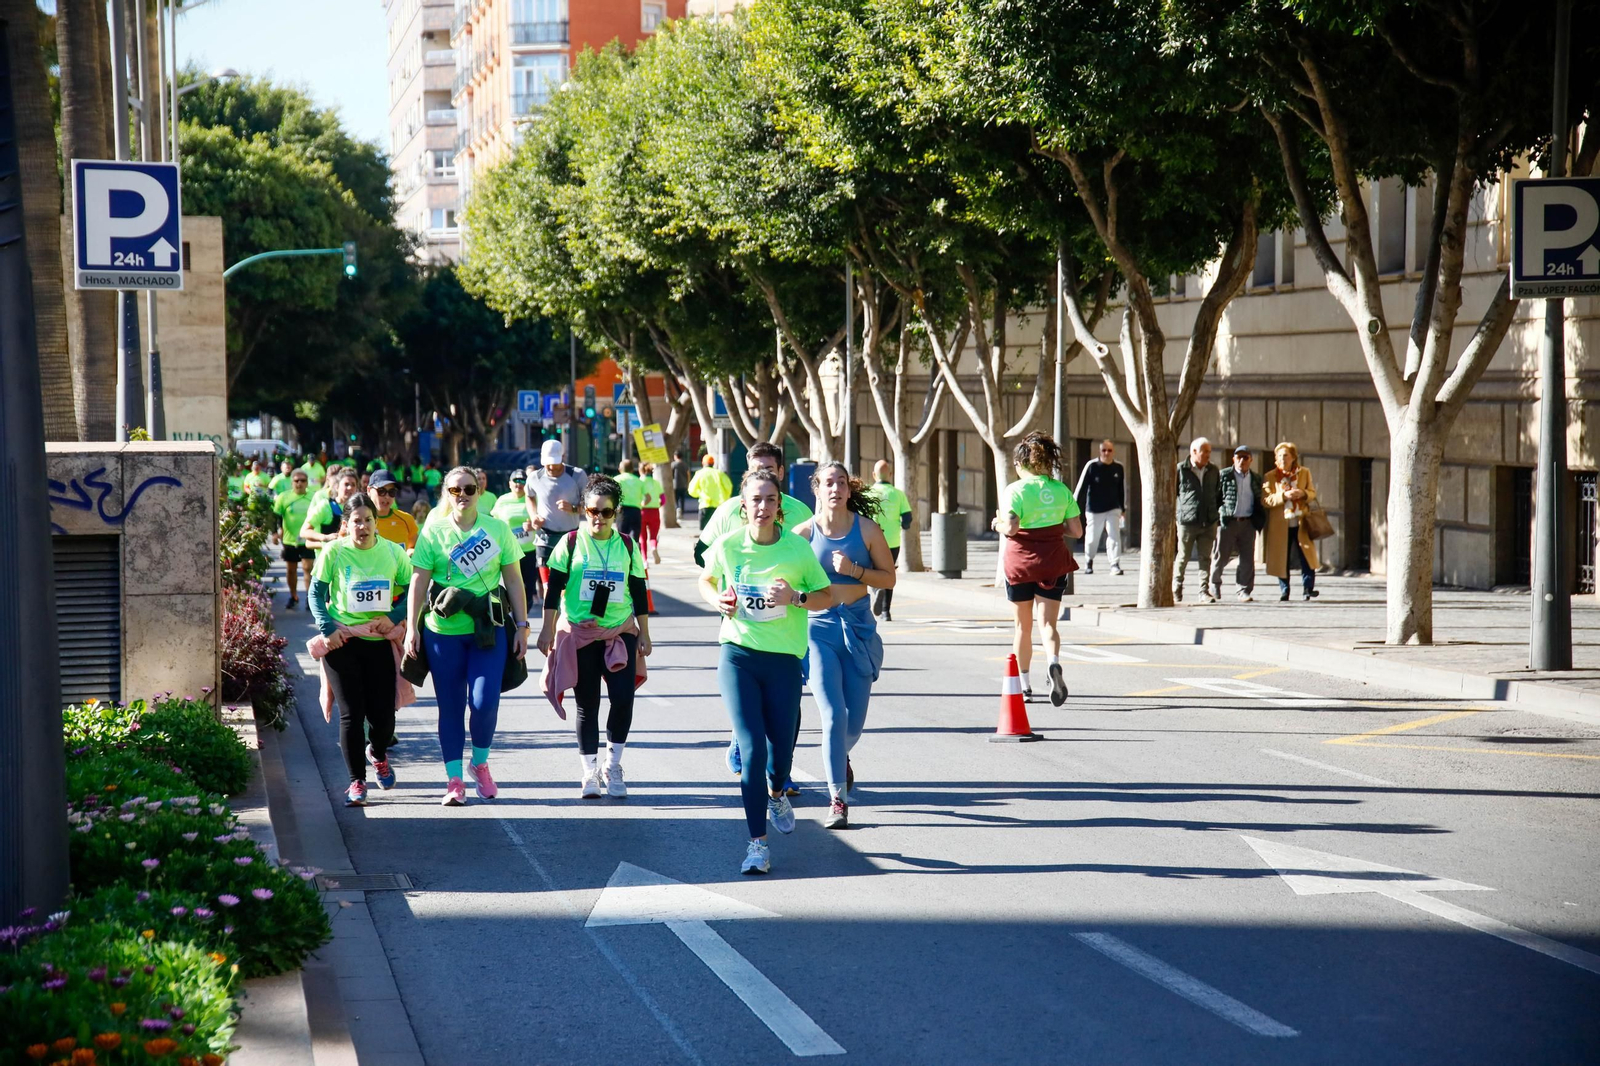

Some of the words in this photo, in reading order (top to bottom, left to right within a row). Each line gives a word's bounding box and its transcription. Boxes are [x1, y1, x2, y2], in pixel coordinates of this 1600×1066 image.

[84, 168, 170, 265] P
[1522, 185, 1600, 277] P
[113, 251, 145, 267] 24h
[1546, 262, 1575, 276] 24h
[85, 275, 115, 285] Hnos.
[118, 276, 174, 286] MACHADO
[1518, 286, 1536, 296] Pza.
[1538, 284, 1566, 295] LÓPEZ
[524, 394, 535, 410] P
[460, 538, 491, 566] 1009
[356, 590, 382, 603] 981
